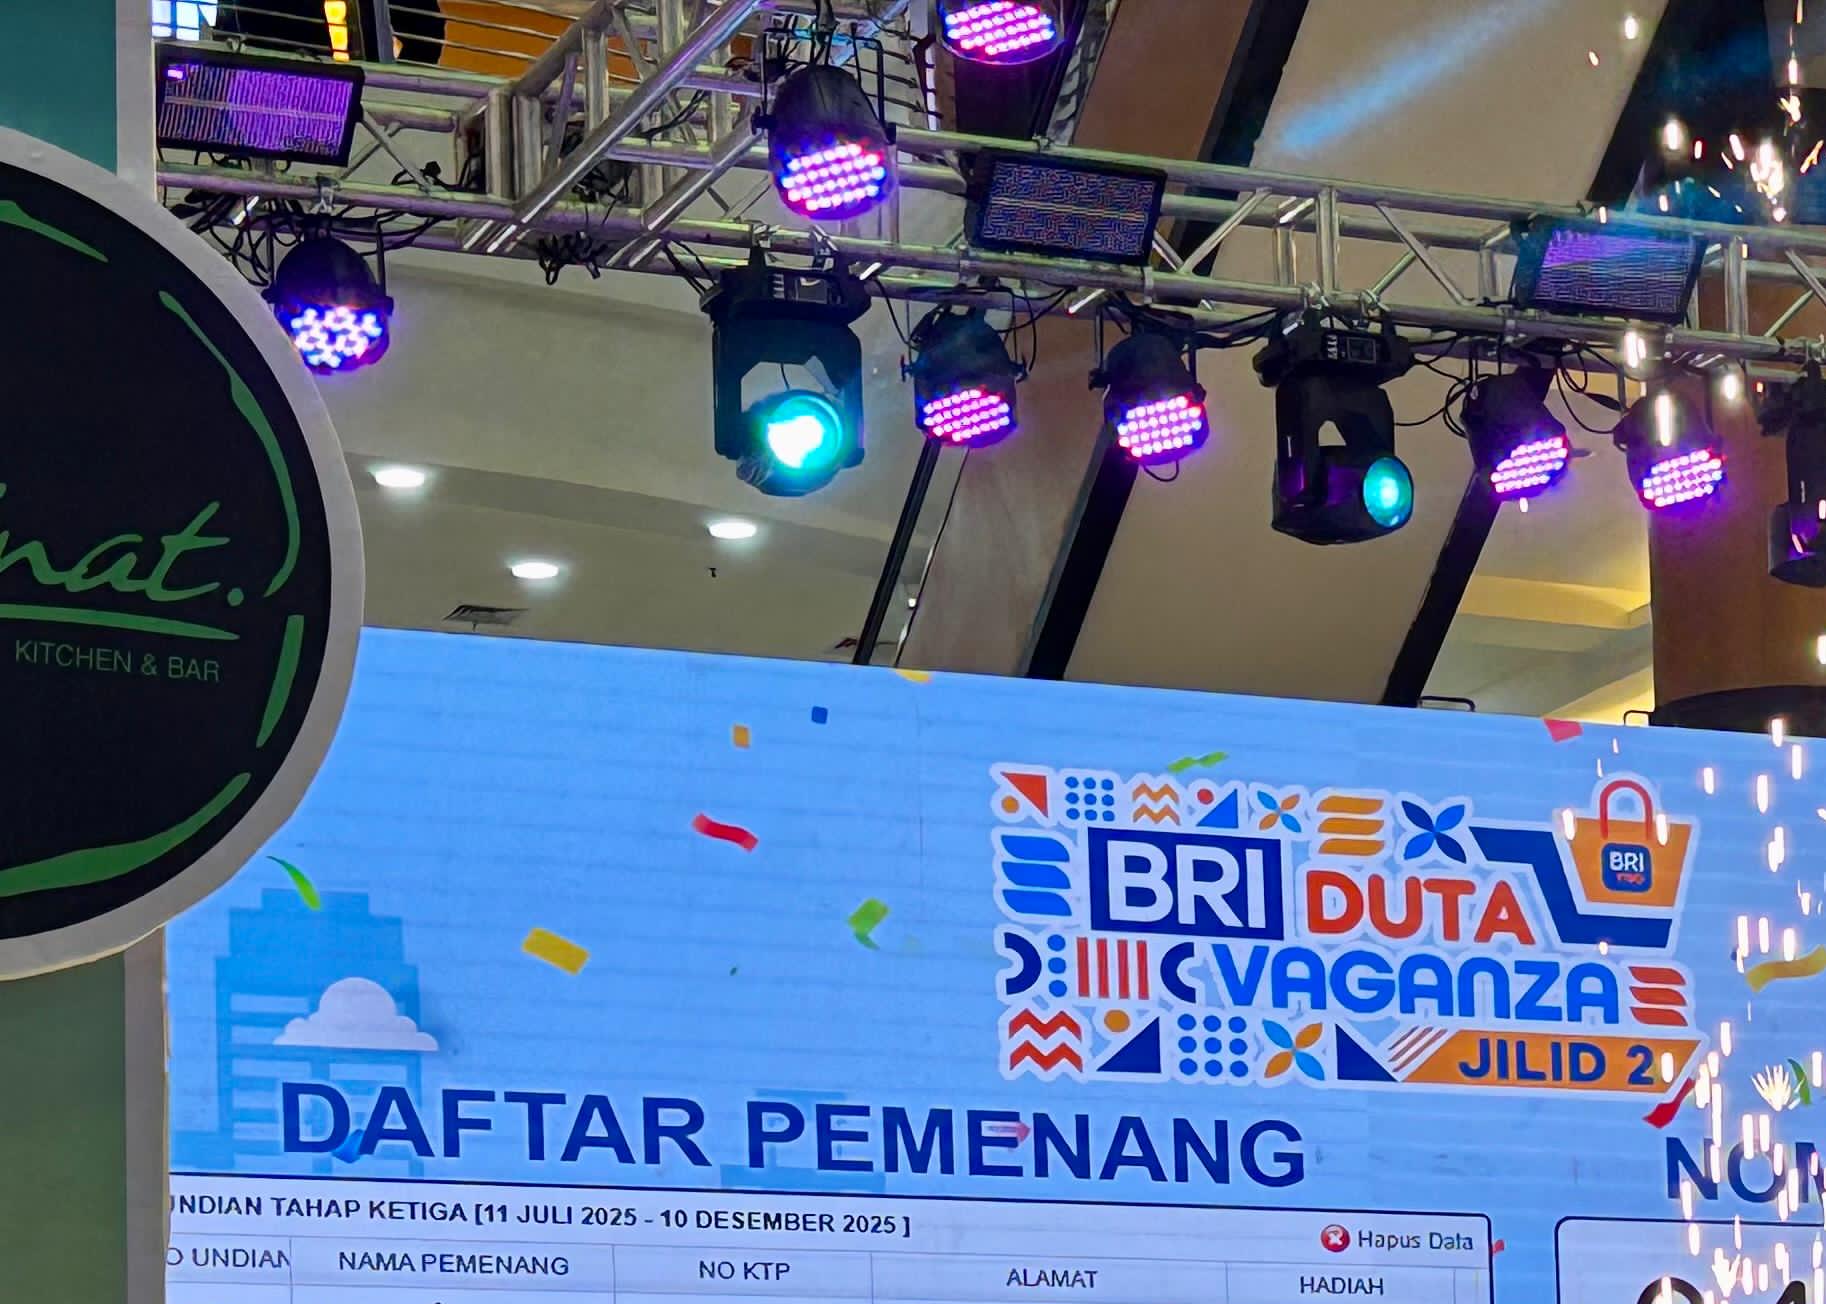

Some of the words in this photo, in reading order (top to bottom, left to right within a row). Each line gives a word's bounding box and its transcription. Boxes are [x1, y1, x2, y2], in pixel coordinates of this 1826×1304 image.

[15, 639, 132, 673] KITCHEN
[141, 652, 158, 676] &
[168, 655, 220, 683] BAR
[1609, 850, 1645, 873] BRI
[1107, 839, 1268, 930] BRI
[1306, 869, 1537, 946] DUTA
[1210, 943, 1620, 1025] VAGANZA
[1458, 1037, 1606, 1083] JILID
[1626, 1044, 1656, 1085] 2
[281, 1081, 713, 1167] DAFTAR
[746, 1100, 1305, 1188] PEMENANG
[271, 1197, 361, 1219] TAHAP
[369, 1201, 468, 1222] KETIGA
[517, 1206, 573, 1225] JULI
[581, 1207, 638, 1228] 2025
[660, 1210, 688, 1229] 10
[696, 1210, 835, 1233] DESEMBER
[843, 1215, 897, 1235] 2025
[1358, 1230, 1421, 1251] Hapus
[191, 1247, 291, 1269] UNDIAN
[339, 1251, 416, 1272] NAMA
[421, 1253, 570, 1275] PEMENANG
[699, 1260, 735, 1280] NO
[743, 1261, 791, 1281] KTP
[1006, 1268, 1098, 1289] ALAMAT
[1299, 1275, 1385, 1296] HADIAH
